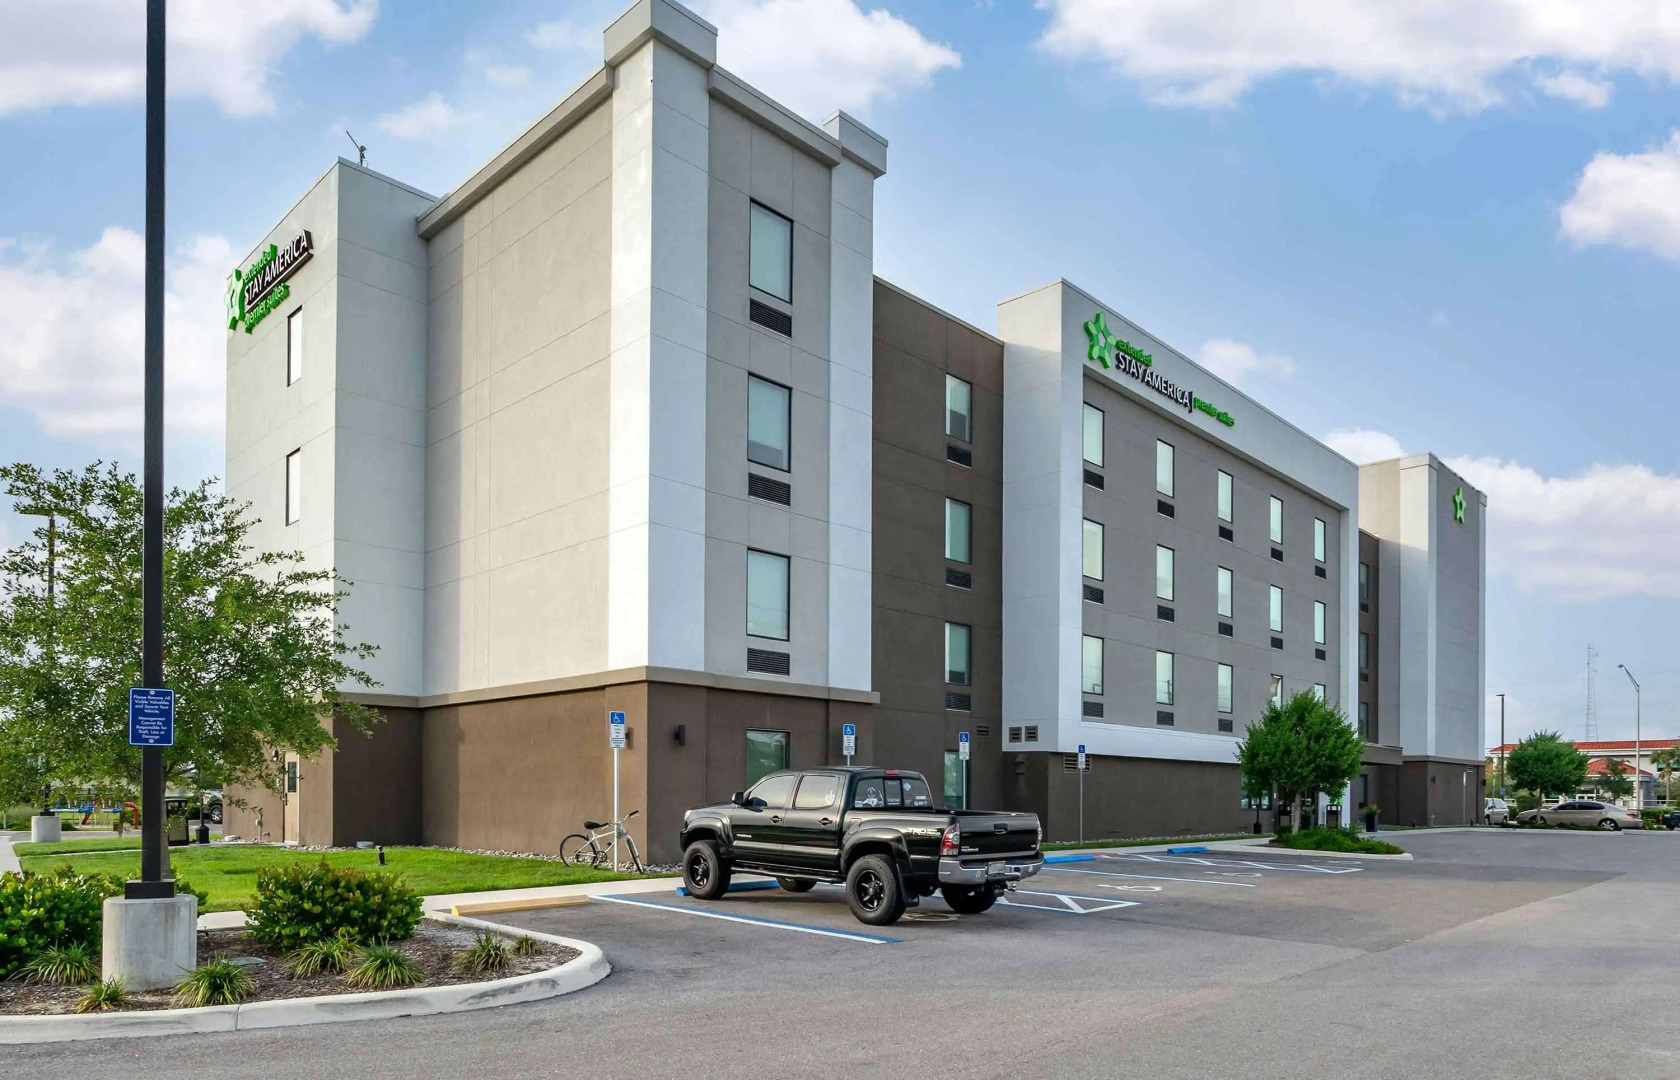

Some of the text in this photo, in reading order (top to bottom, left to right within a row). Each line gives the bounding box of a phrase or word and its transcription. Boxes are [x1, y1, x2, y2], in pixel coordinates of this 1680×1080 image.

[244, 229, 311, 306] STAY AMERICA
[1117, 339, 1152, 367] extended
[1117, 351, 1144, 380] STAY
[1143, 367, 1190, 408] AMERICA
